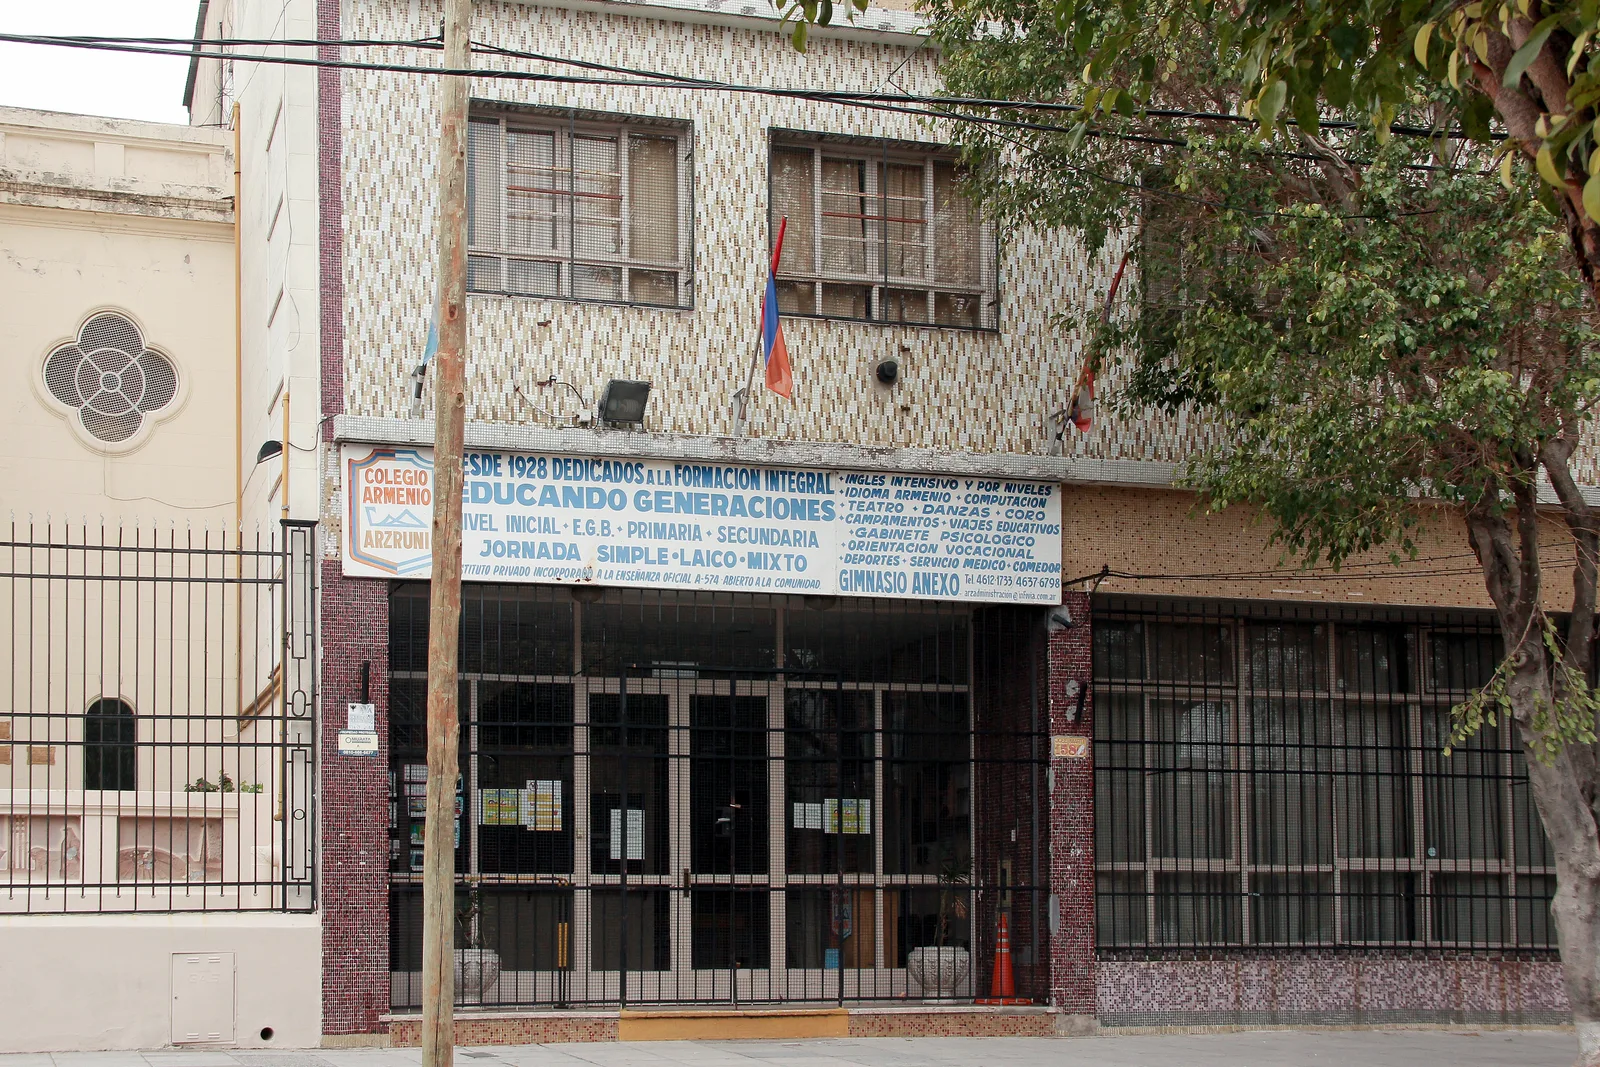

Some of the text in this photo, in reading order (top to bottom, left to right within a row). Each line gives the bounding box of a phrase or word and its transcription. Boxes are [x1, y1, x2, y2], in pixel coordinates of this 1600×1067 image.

[364, 468, 428, 485] COLEGIO
[463, 453, 835, 495] ESDE 1928 DEDICADOS A LA FORMACION INTEGRAL
[363, 486, 432, 506] ARMENIO
[845, 474, 1052, 497] INGLES INTENSIVO Y POR NIVELES
[633, 489, 836, 522] GENERACIONES
[845, 487, 1047, 509] IDIOMA ARMENIO COMPUTACION
[848, 500, 1046, 522] TEATRO DANZAS CORO
[462, 512, 819, 549] IVEL INICIAL E.G.B. PRIMARIA SECUNDARIA
[845, 513, 1060, 535] CAMPAMENTOS VIAJES EDUCATIVOS
[363, 530, 430, 550] ARZRUNI
[855, 527, 1036, 547] GABINETE PSICOLOGICO
[480, 539, 808, 573] JORNADA SIMPLE LAICO MIXTO
[847, 540, 1035, 560] ORIENTACION VOCACIONAL
[843, 553, 1061, 574] DEPORTES SERVICIO MEDICO COMEDOR
[463, 564, 491, 576] TITUTO
[493, 565, 531, 578] PRIVADO
[533, 567, 594, 580] INCORPORADO
[596, 569, 603, 580] A
[604, 570, 615, 581] LA
[663, 573, 691, 584] OFICIAL
[755, 577, 762, 587] A
[763, 577, 772, 588] LA
[839, 568, 960, 596] GIMNASIO ANEXO
